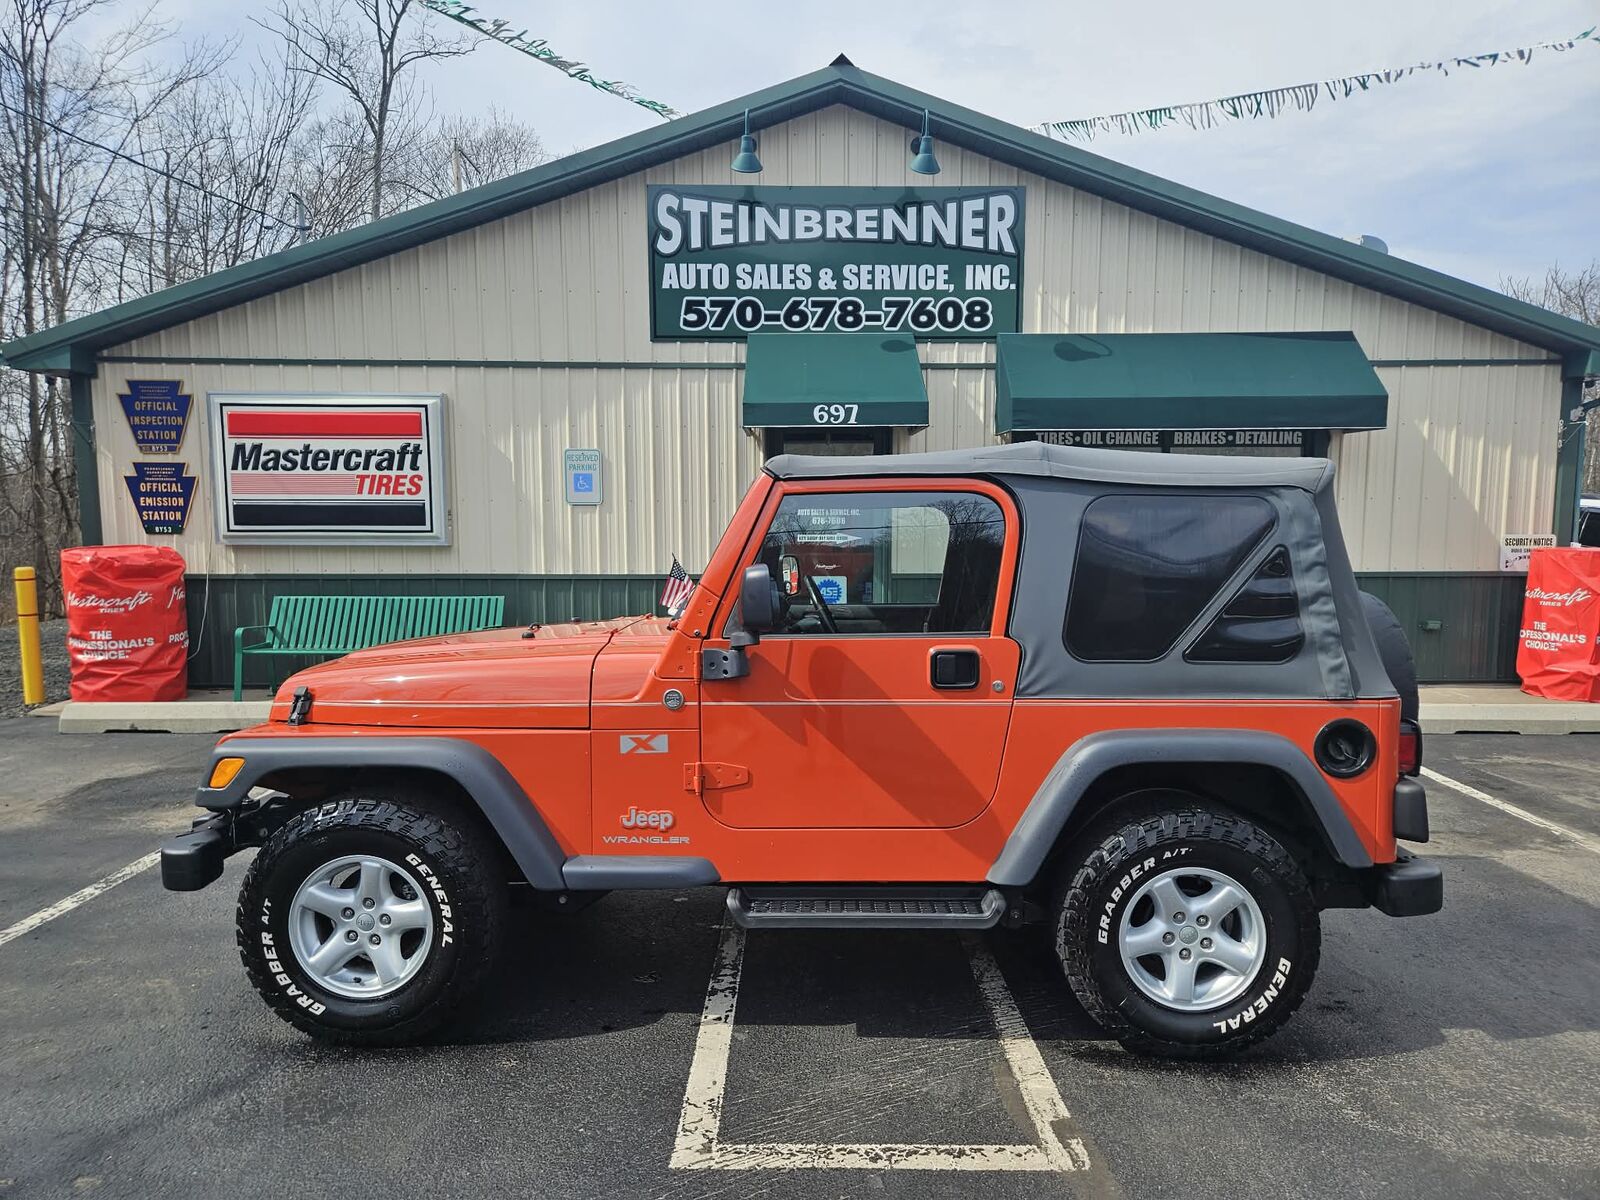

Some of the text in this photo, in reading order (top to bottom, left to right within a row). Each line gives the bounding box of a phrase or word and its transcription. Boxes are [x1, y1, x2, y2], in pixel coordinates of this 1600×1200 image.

[656, 193, 1015, 253] STEINBRENNER
[662, 263, 1016, 293] AUTO SALES & SERVICE, INC.
[680, 296, 993, 332] 570-678-7608
[134, 401, 179, 411] OFFICIAL
[813, 404, 859, 424] 697
[130, 416, 184, 426] INSPECTION
[137, 430, 177, 440] STATION
[1036, 432, 1159, 445] TIRES OIL CHANGE
[1173, 431, 1303, 445] BRAKES DETAILING
[231, 442, 423, 471] Mastercraft
[567, 454, 599, 462] RESERVED
[140, 482, 183, 492] OFFICIAL
[355, 474, 424, 496] TIRES
[140, 497, 184, 506] EMISSION
[142, 511, 182, 520] STATION
[1504, 537, 1553, 546] SECURITY NOTICE
[820, 587, 838, 596] ASE
[1534, 621, 1547, 631] THE
[89, 630, 113, 639] THE
[621, 807, 674, 832] Jeep
[602, 835, 690, 844] WRANGLER
[405, 852, 454, 948] GENERAL
[1098, 857, 1156, 945] GRABBER
[261, 897, 326, 1016] GRABBER A/T
[1213, 957, 1292, 1034] GENERAL
